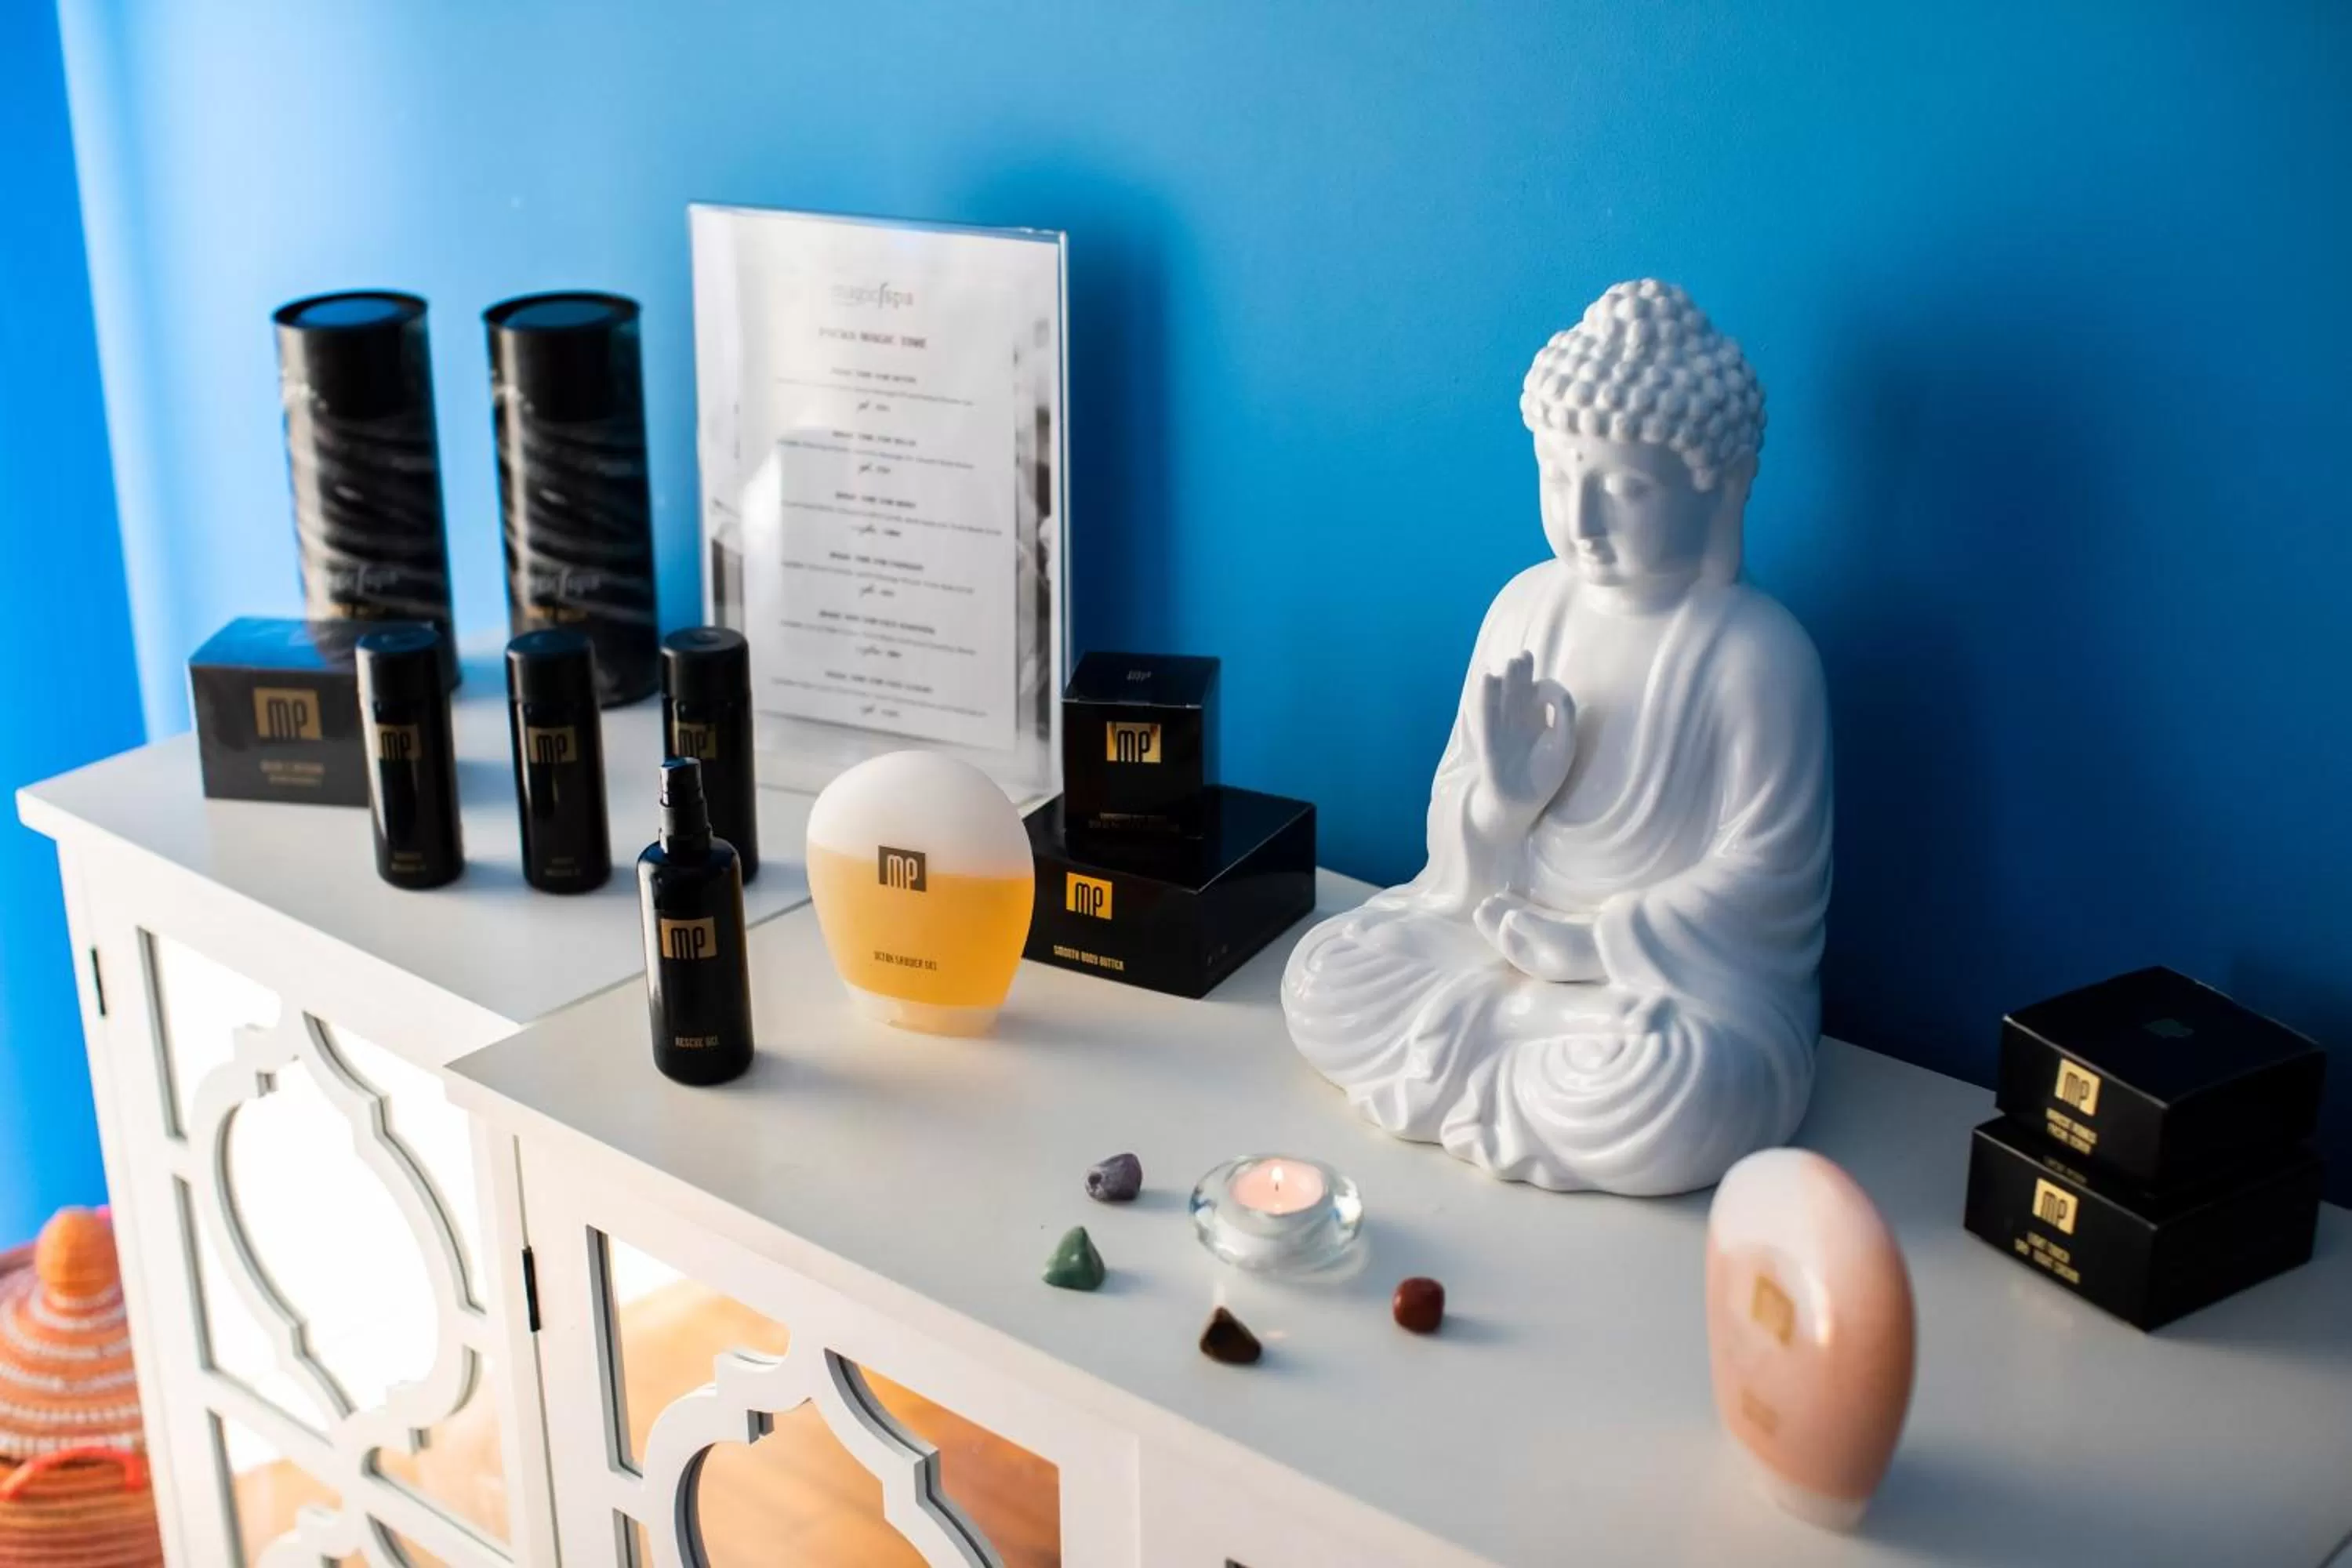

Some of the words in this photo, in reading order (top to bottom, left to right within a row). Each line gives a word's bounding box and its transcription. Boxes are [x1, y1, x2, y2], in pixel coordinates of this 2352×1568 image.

[265, 695, 310, 739] MP
[379, 730, 412, 760] MP
[535, 733, 568, 764] MP
[1116, 729, 1152, 763] MP
[885, 853, 919, 891] MP
[1075, 880, 1104, 916] MP
[670, 926, 706, 960] MP
[2062, 1069, 2091, 1109] MP
[2040, 1190, 2068, 1228] MP
